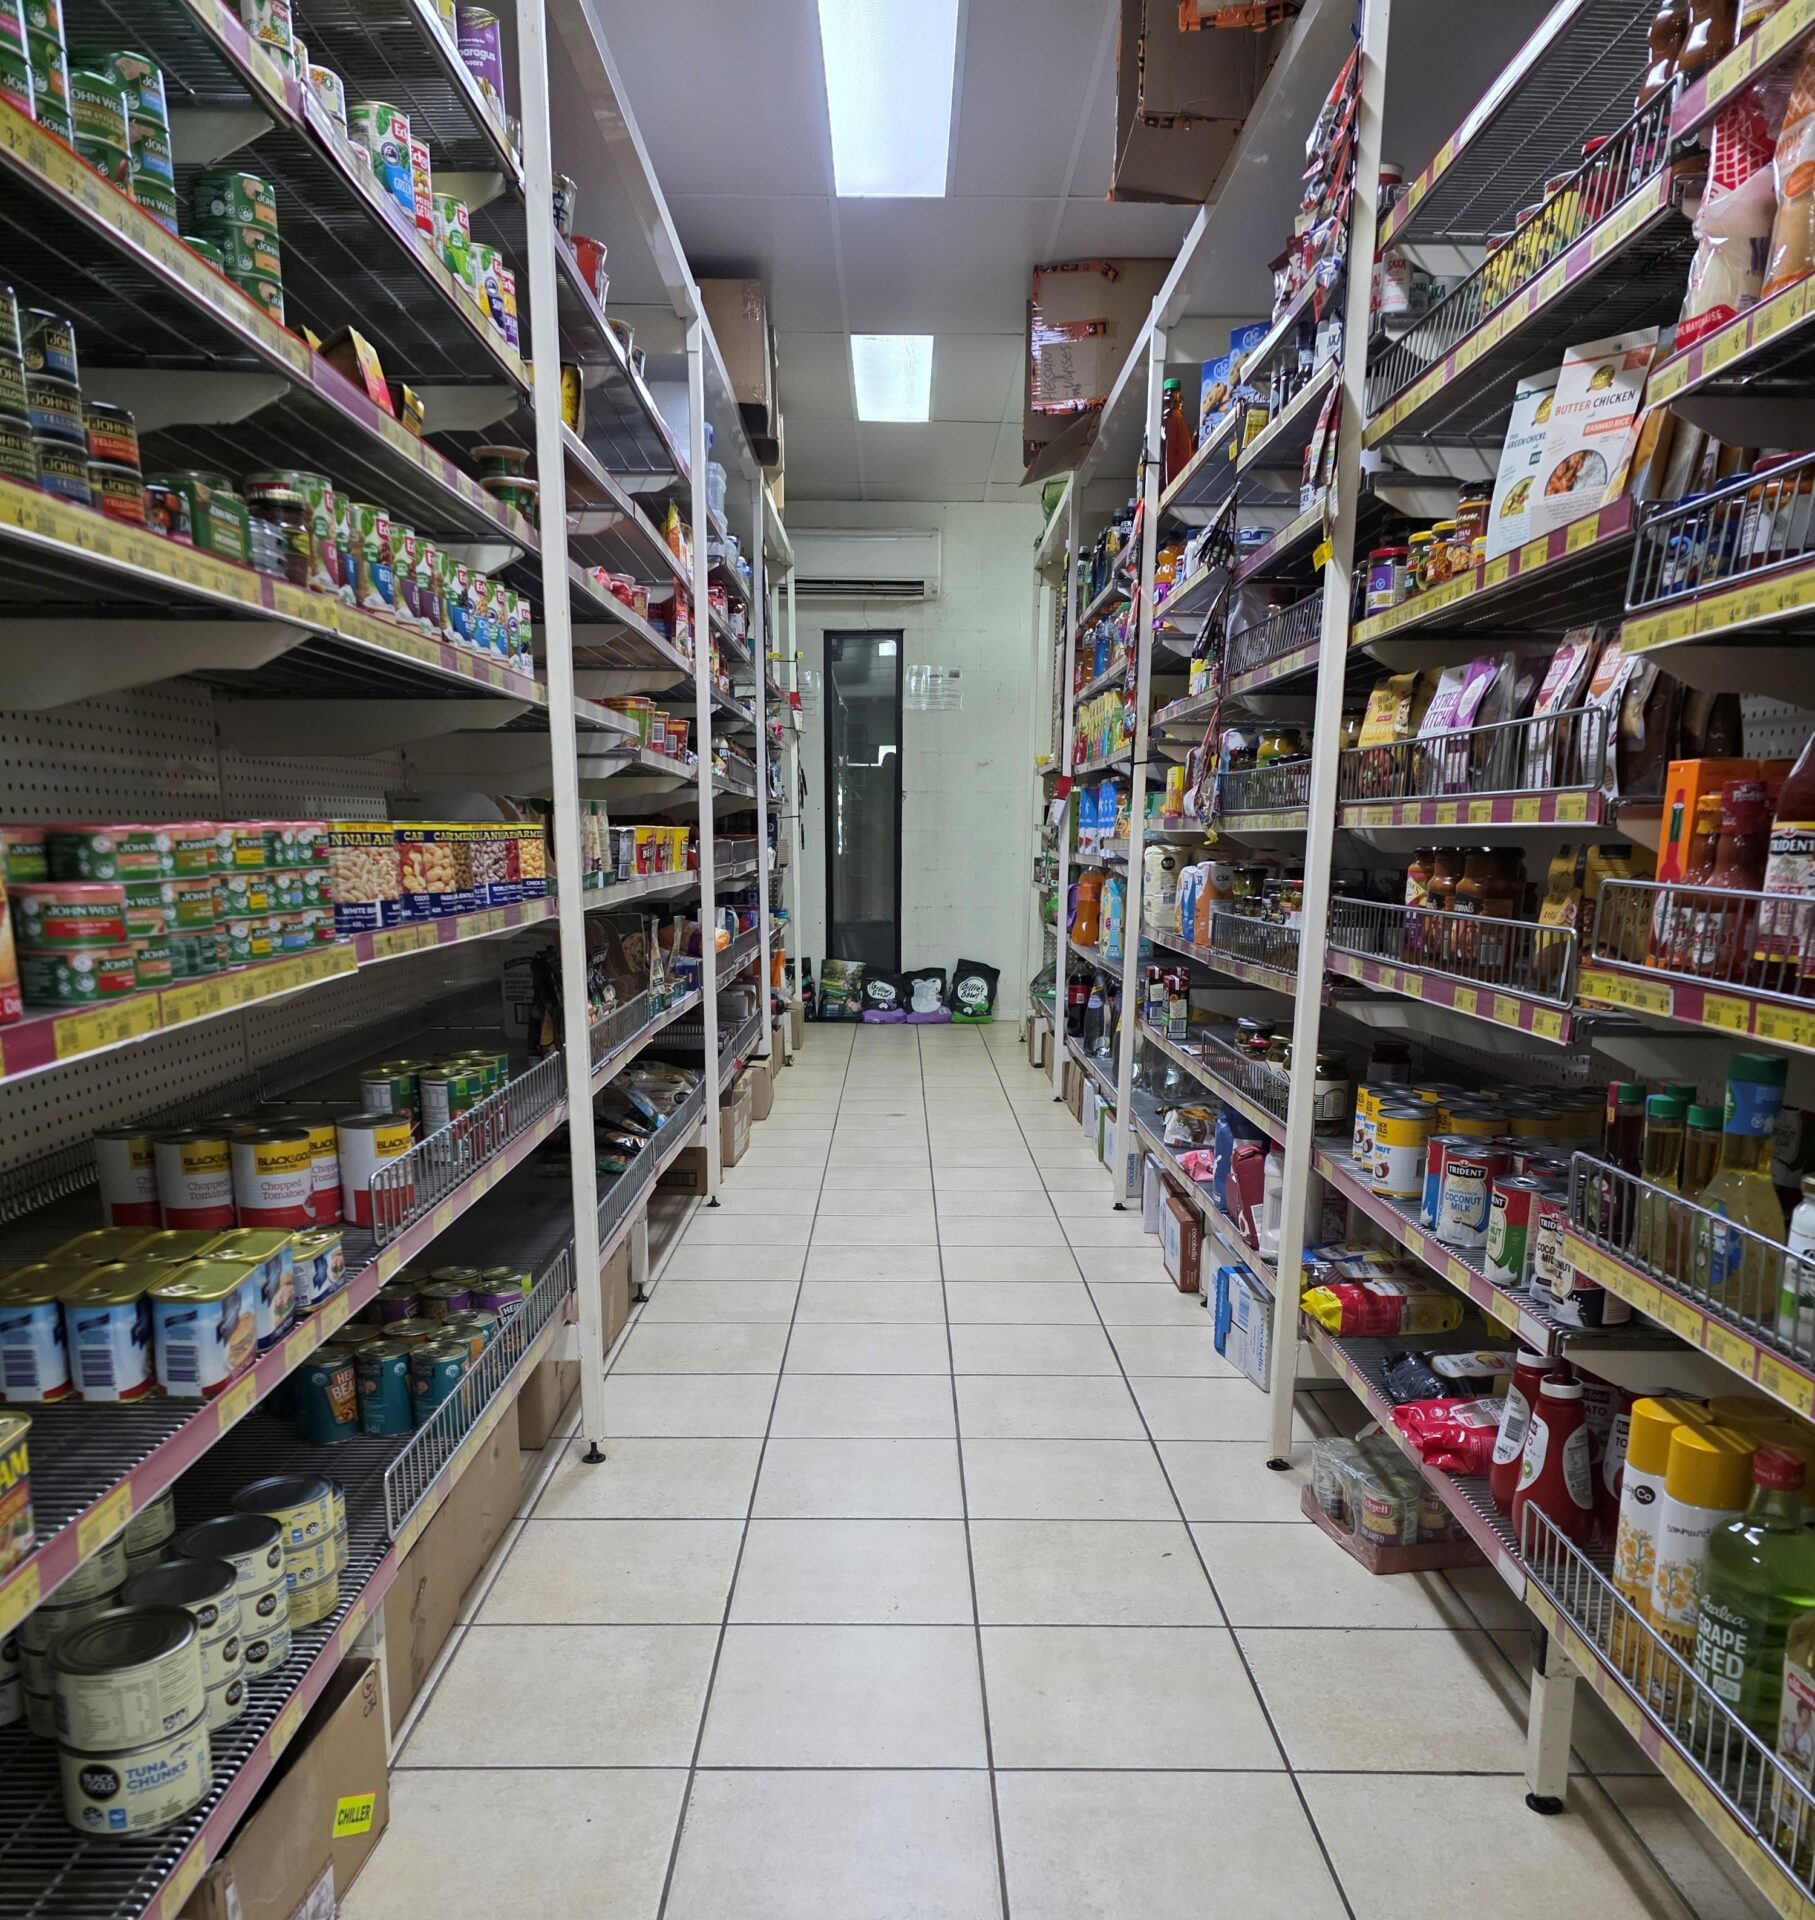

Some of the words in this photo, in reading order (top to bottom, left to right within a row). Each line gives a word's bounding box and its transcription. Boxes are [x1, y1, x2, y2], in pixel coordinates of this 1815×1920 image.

[71, 88, 100, 104] OHN
[1555, 400, 1592, 417] BUTTER
[1593, 389, 1637, 408] CHICKEN
[1613, 416, 1631, 428] RICE
[1526, 431, 1547, 446] CHICKE
[48, 906, 88, 916] JOHN
[90, 904, 119, 915] WEST
[1448, 1165, 1484, 1178] TRIDENT
[261, 1178, 302, 1191] Chopped
[262, 1187, 306, 1201] Tomatoes
[1445, 1191, 1482, 1206] COCONUT
[1451, 1200, 1471, 1213] MILK
[1540, 1217, 1556, 1230] TRID
[1538, 1242, 1556, 1255] COCO
[332, 1384, 354, 1401] BEA
[1700, 1594, 1749, 1630] Azalea
[1698, 1612, 1748, 1655] GRAPE
[1662, 1629, 1694, 1656] CAN
[1695, 1634, 1745, 1680] SEED
[124, 1760, 168, 1779] TUNA
[126, 1760, 188, 1790] CHUNKS
[83, 1772, 113, 1783] BLACK
[88, 1780, 117, 1791] GOLD
[337, 1804, 371, 1826] CHILLER
